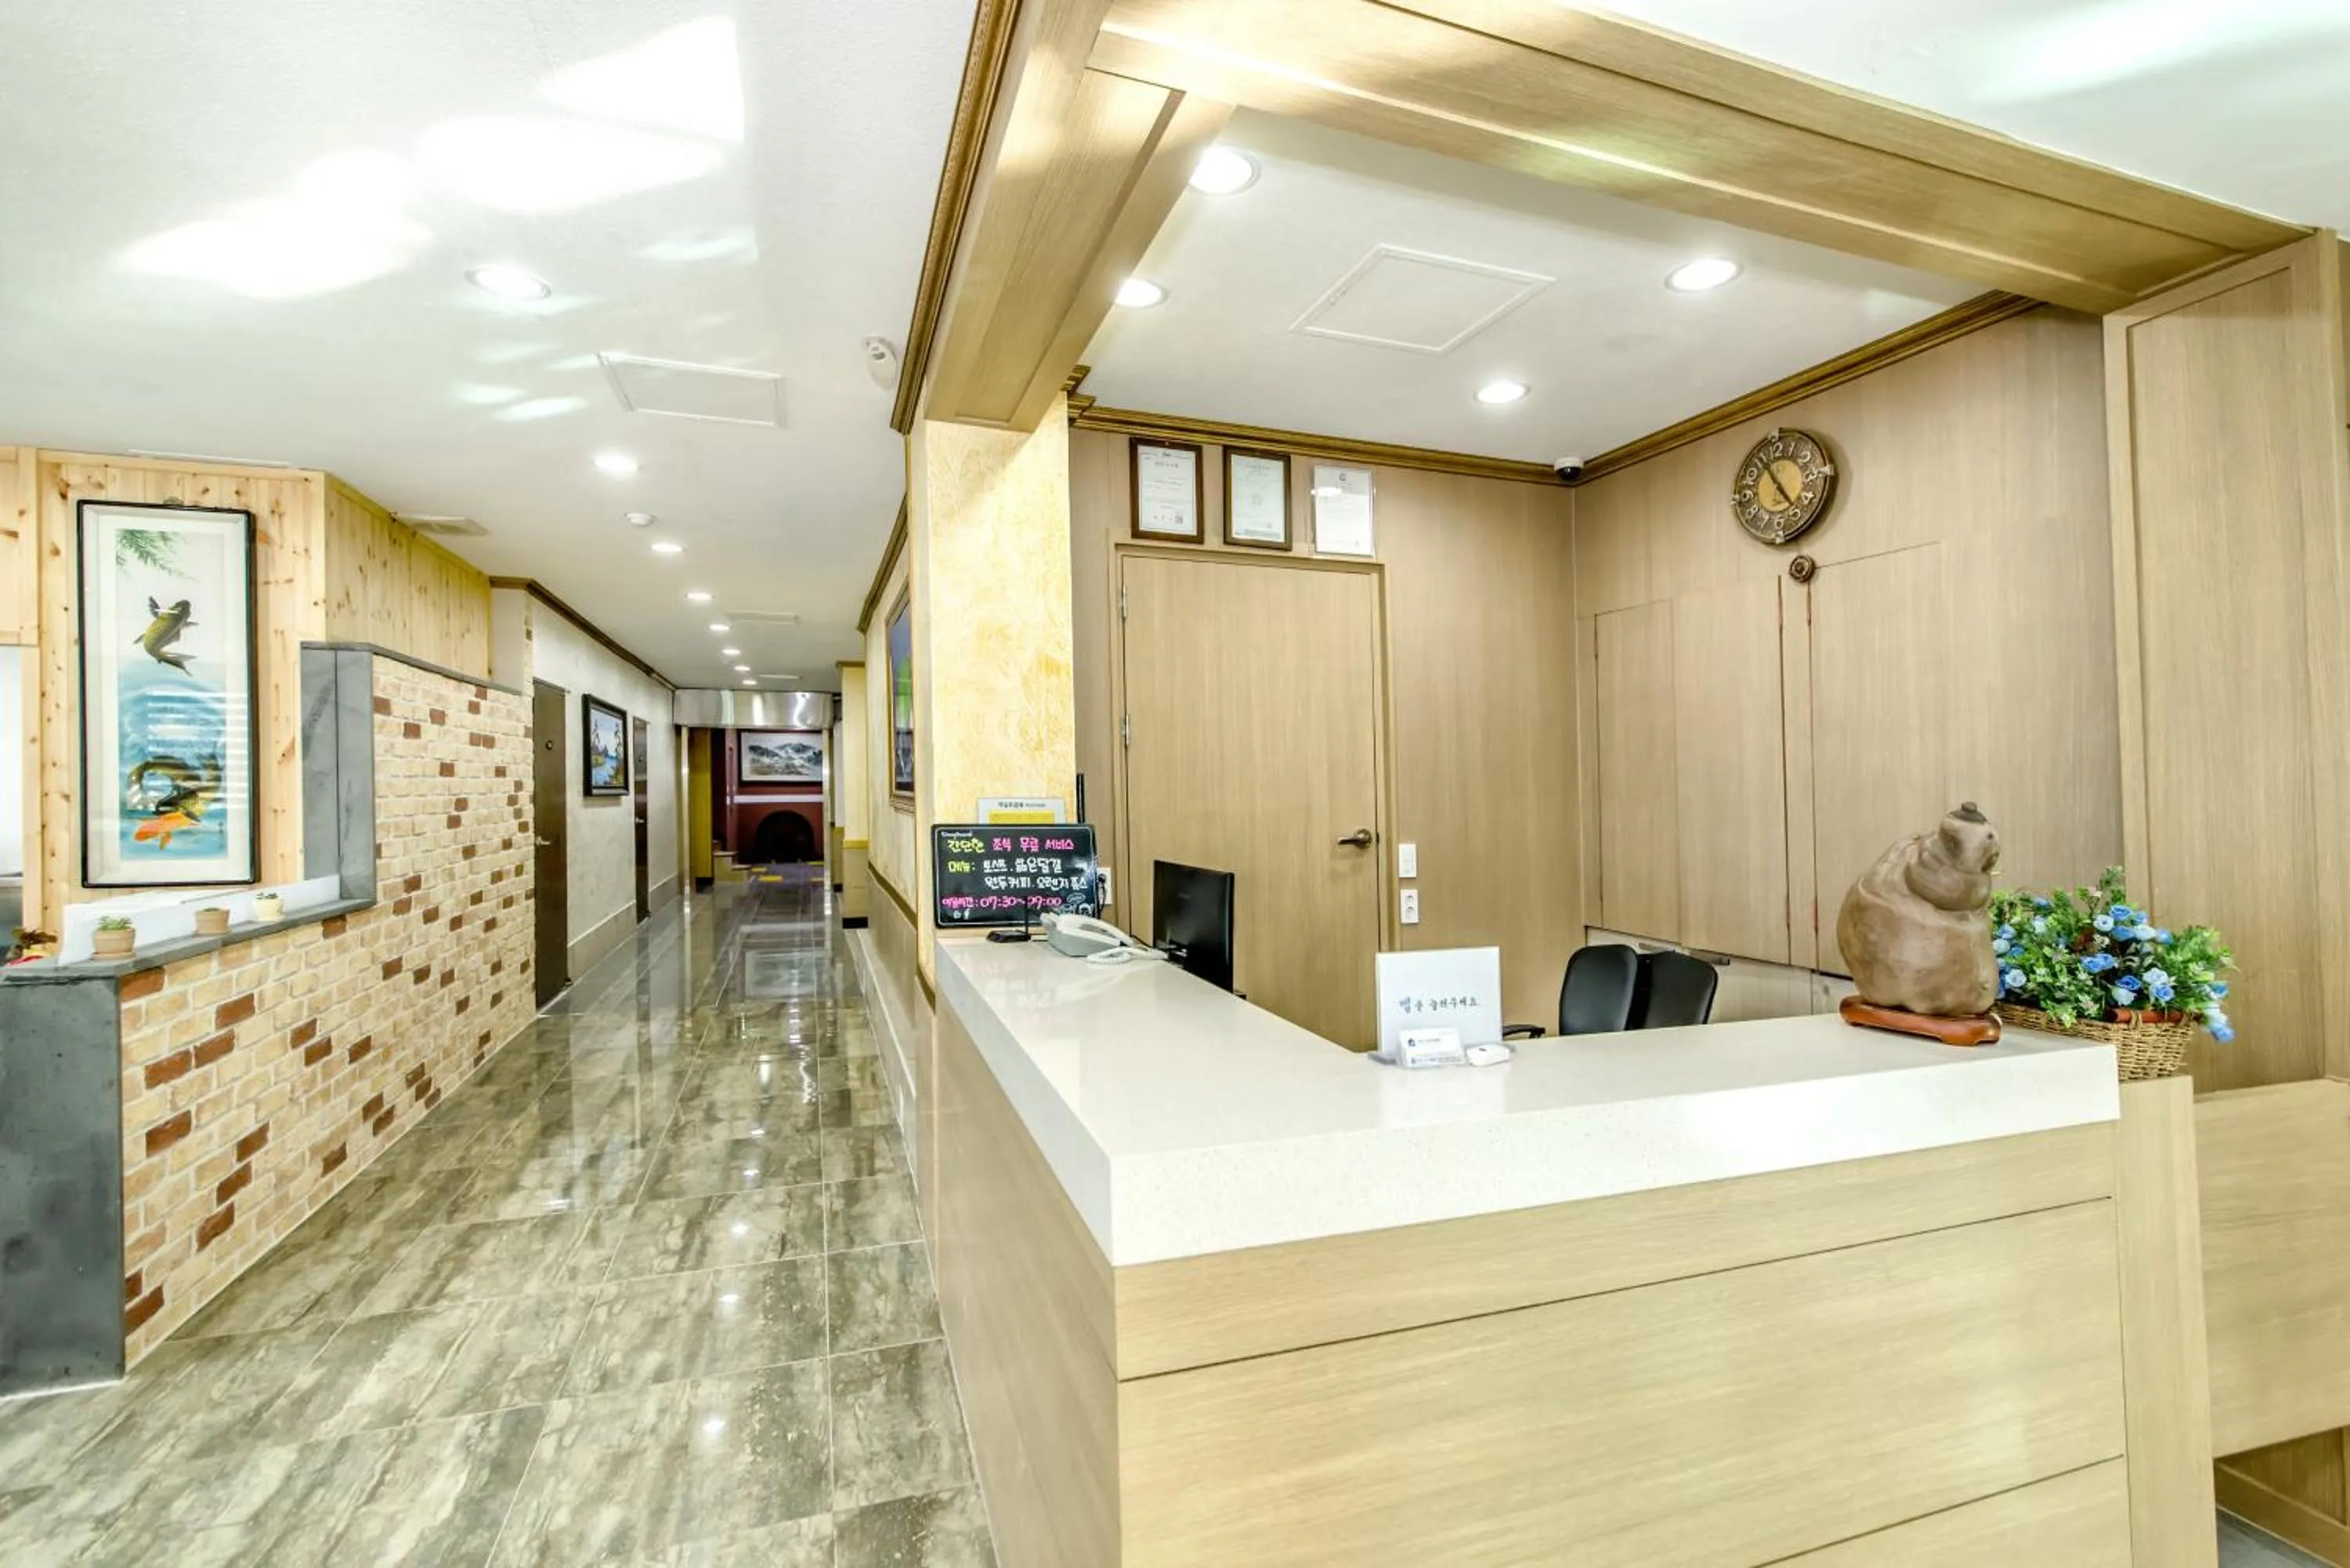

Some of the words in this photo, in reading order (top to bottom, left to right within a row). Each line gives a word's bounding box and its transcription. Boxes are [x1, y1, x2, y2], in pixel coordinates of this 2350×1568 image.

[1769, 443, 1783, 460] 12
[1789, 442, 1795, 456] 1
[1754, 453, 1767, 469] 11
[1743, 468, 1757, 486] 10
[1741, 490, 1754, 502] 9
[1802, 491, 1814, 504] 4
[1789, 505, 1802, 521] 5
[1761, 515, 1770, 529] 7
[1773, 516, 1784, 529] 6
[948, 837, 985, 852] 간단한
[992, 837, 1012, 852] 조식
[1020, 836, 1039, 852] 무료
[1044, 839, 1075, 851] 서비스
[1429, 995, 1480, 1011] 눌러주세요
